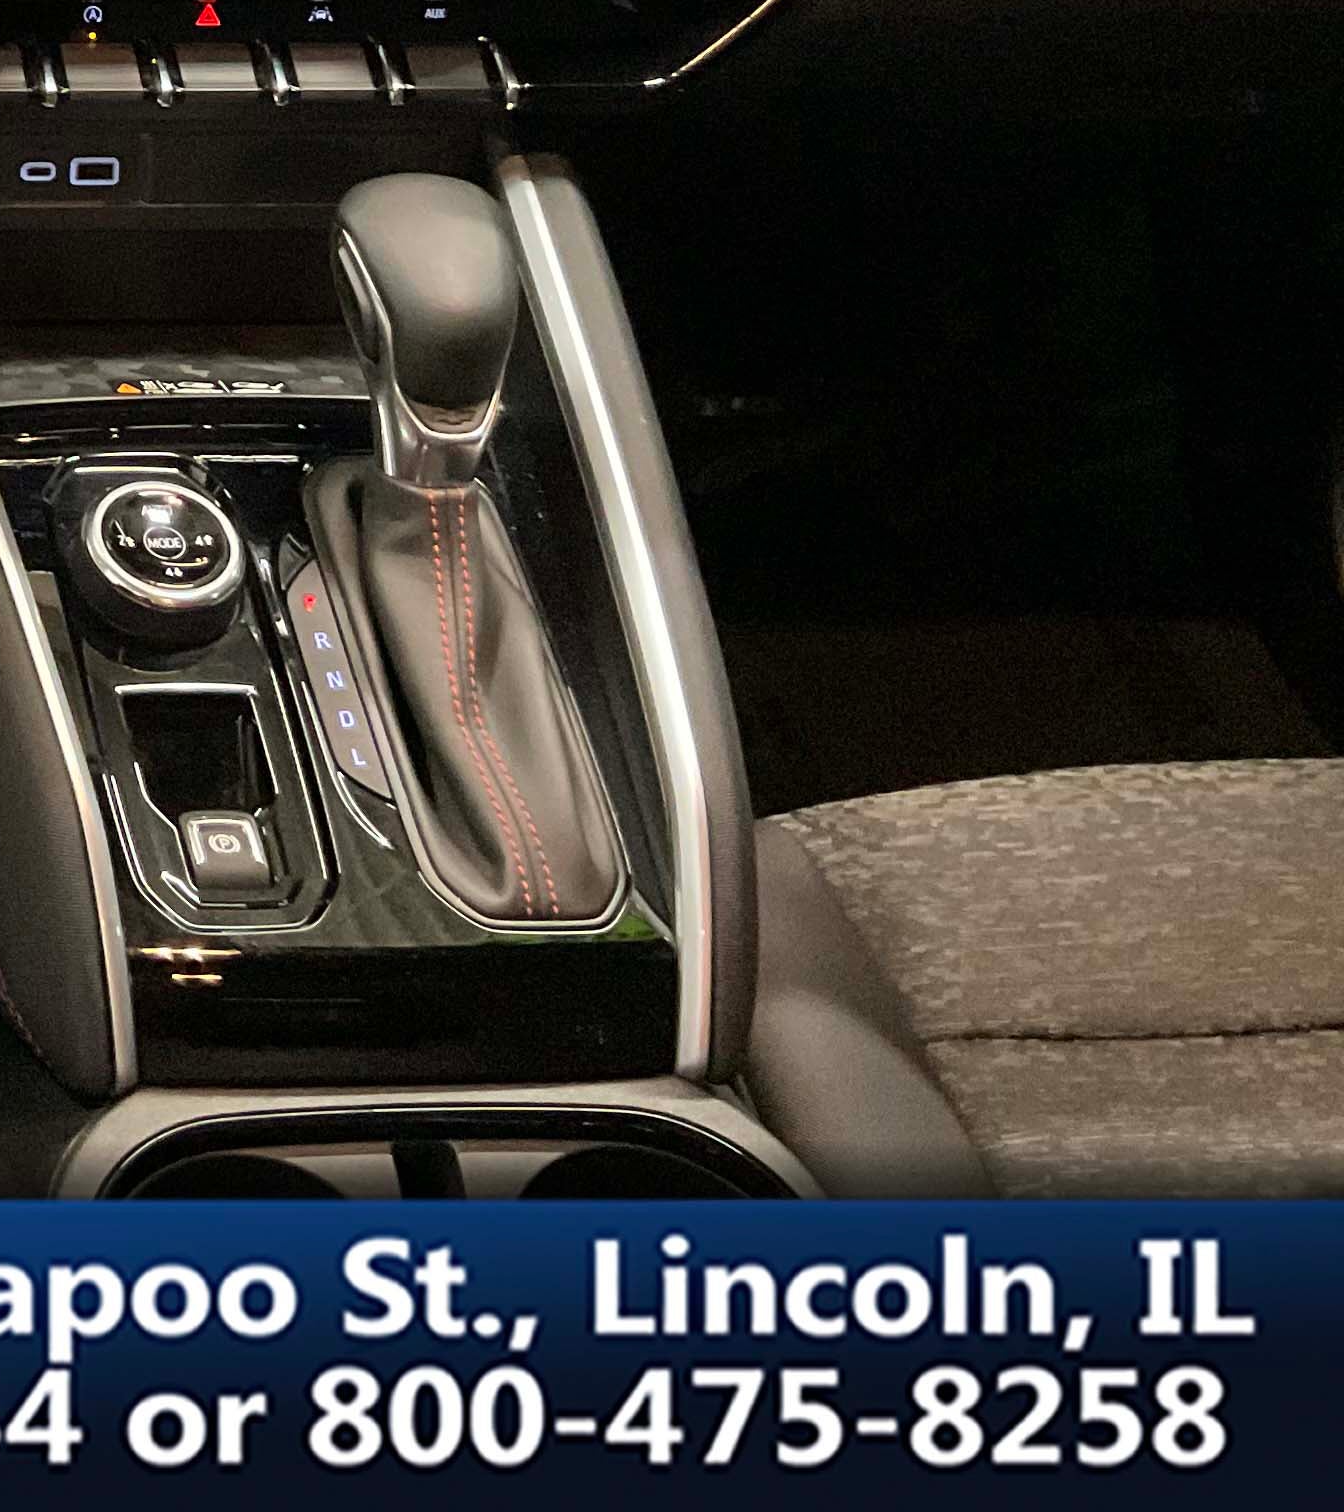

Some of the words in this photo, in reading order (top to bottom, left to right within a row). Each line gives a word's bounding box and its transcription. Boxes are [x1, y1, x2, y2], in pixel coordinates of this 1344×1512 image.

[424, 7, 446, 20] AUX
[148, 538, 181, 549] MODE
[314, 632, 332, 649] R
[326, 671, 344, 688] N
[338, 711, 355, 728] D
[352, 748, 367, 765] L
